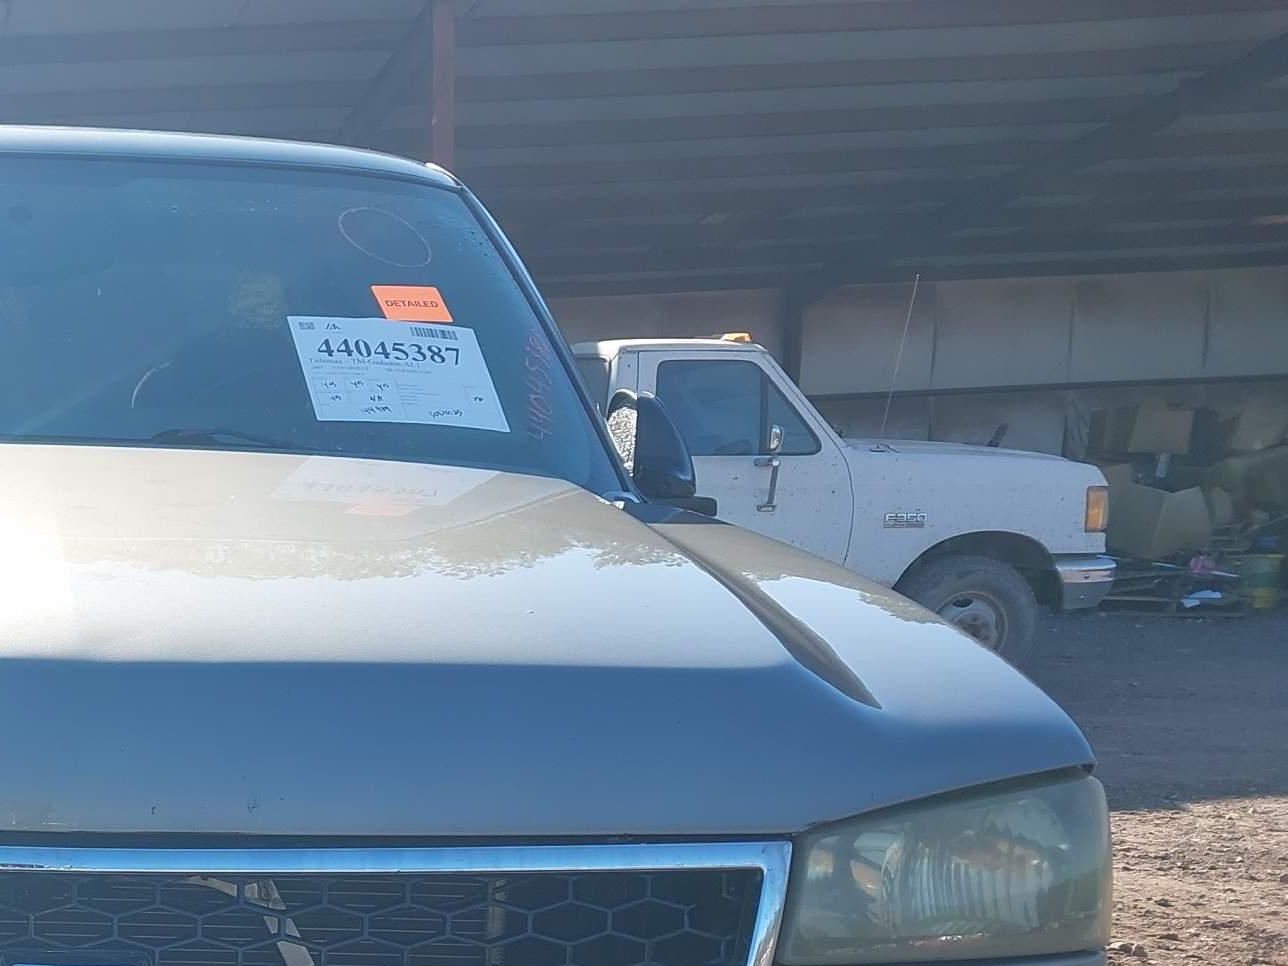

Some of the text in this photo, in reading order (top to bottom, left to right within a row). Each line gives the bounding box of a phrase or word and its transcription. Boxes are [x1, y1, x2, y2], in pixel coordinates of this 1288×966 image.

[385, 299, 439, 309] DETAILED
[317, 338, 460, 366] 44045387
[885, 512, 928, 522] F350
